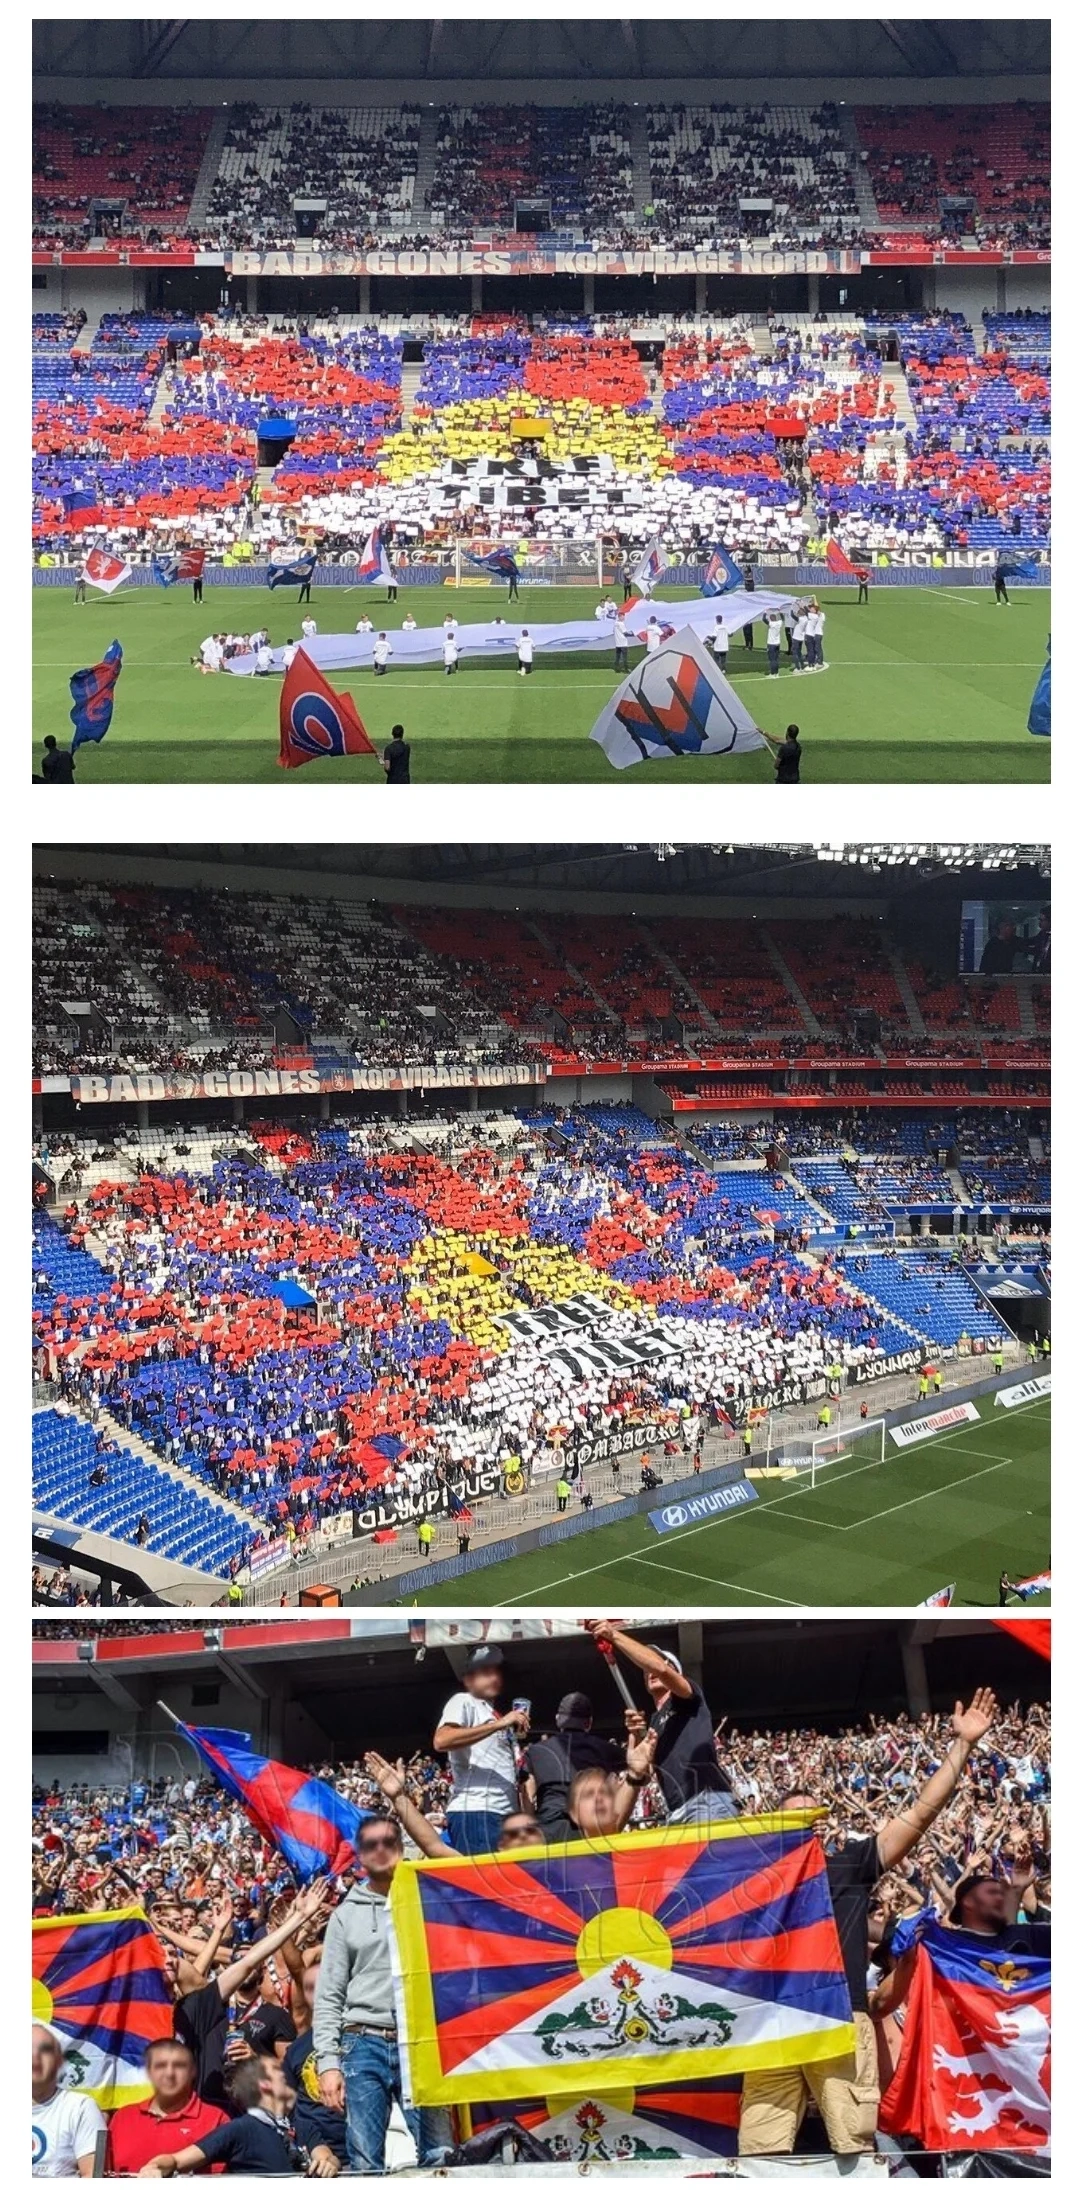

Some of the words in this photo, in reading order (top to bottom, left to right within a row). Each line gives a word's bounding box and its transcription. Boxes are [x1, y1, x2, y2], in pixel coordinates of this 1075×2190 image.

[232, 251, 321, 275] BAD
[365, 251, 511, 275] GONES
[556, 252, 618, 273] KOP
[622, 252, 735, 273] VIRAGE
[739, 252, 828, 273] NORD
[352, 1067, 398, 1090] KOP
[401, 1066, 475, 1089] VIRAGE
[476, 1065, 530, 1085] NORD
[810, 1060, 841, 1068] Groupama
[905, 1060, 938, 1068] Groupama
[79, 1073, 165, 1103] BAD
[203, 1069, 321, 1098] GONES
[498, 1294, 613, 1336] FREE
[856, 1350, 922, 1382] LYONNAIS
[687, 1484, 749, 1518] HYUNDAI
[399, 1554, 464, 1596] OLYMPIQUE
